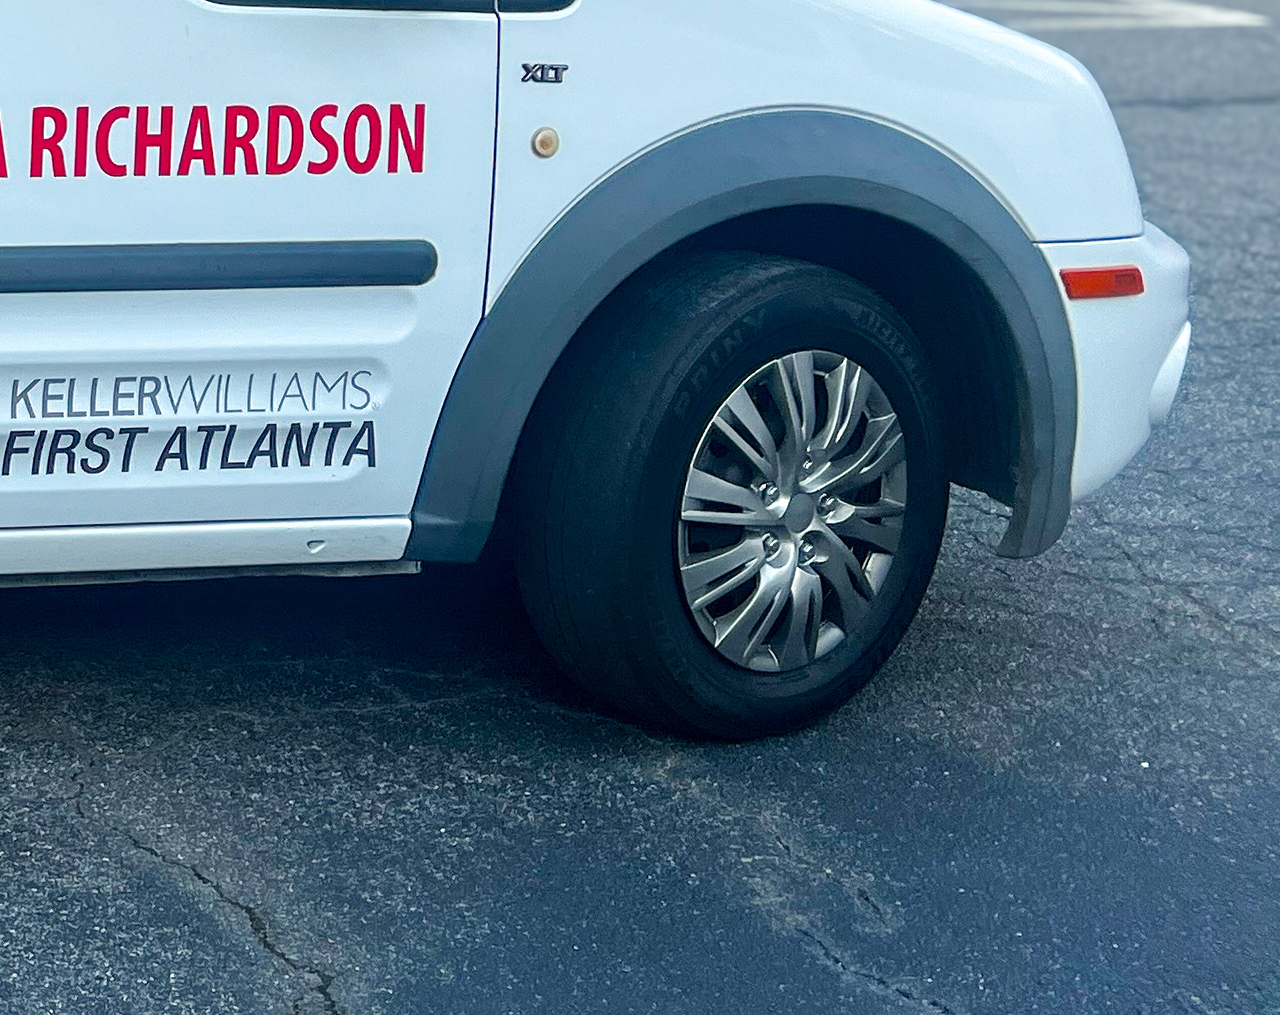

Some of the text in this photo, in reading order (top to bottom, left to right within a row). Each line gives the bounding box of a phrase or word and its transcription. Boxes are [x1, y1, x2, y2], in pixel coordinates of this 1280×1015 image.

[521, 64, 568, 83] XLT
[31, 104, 424, 176] RICHARDSON
[1, 421, 375, 476] FIRST ATLANTA
